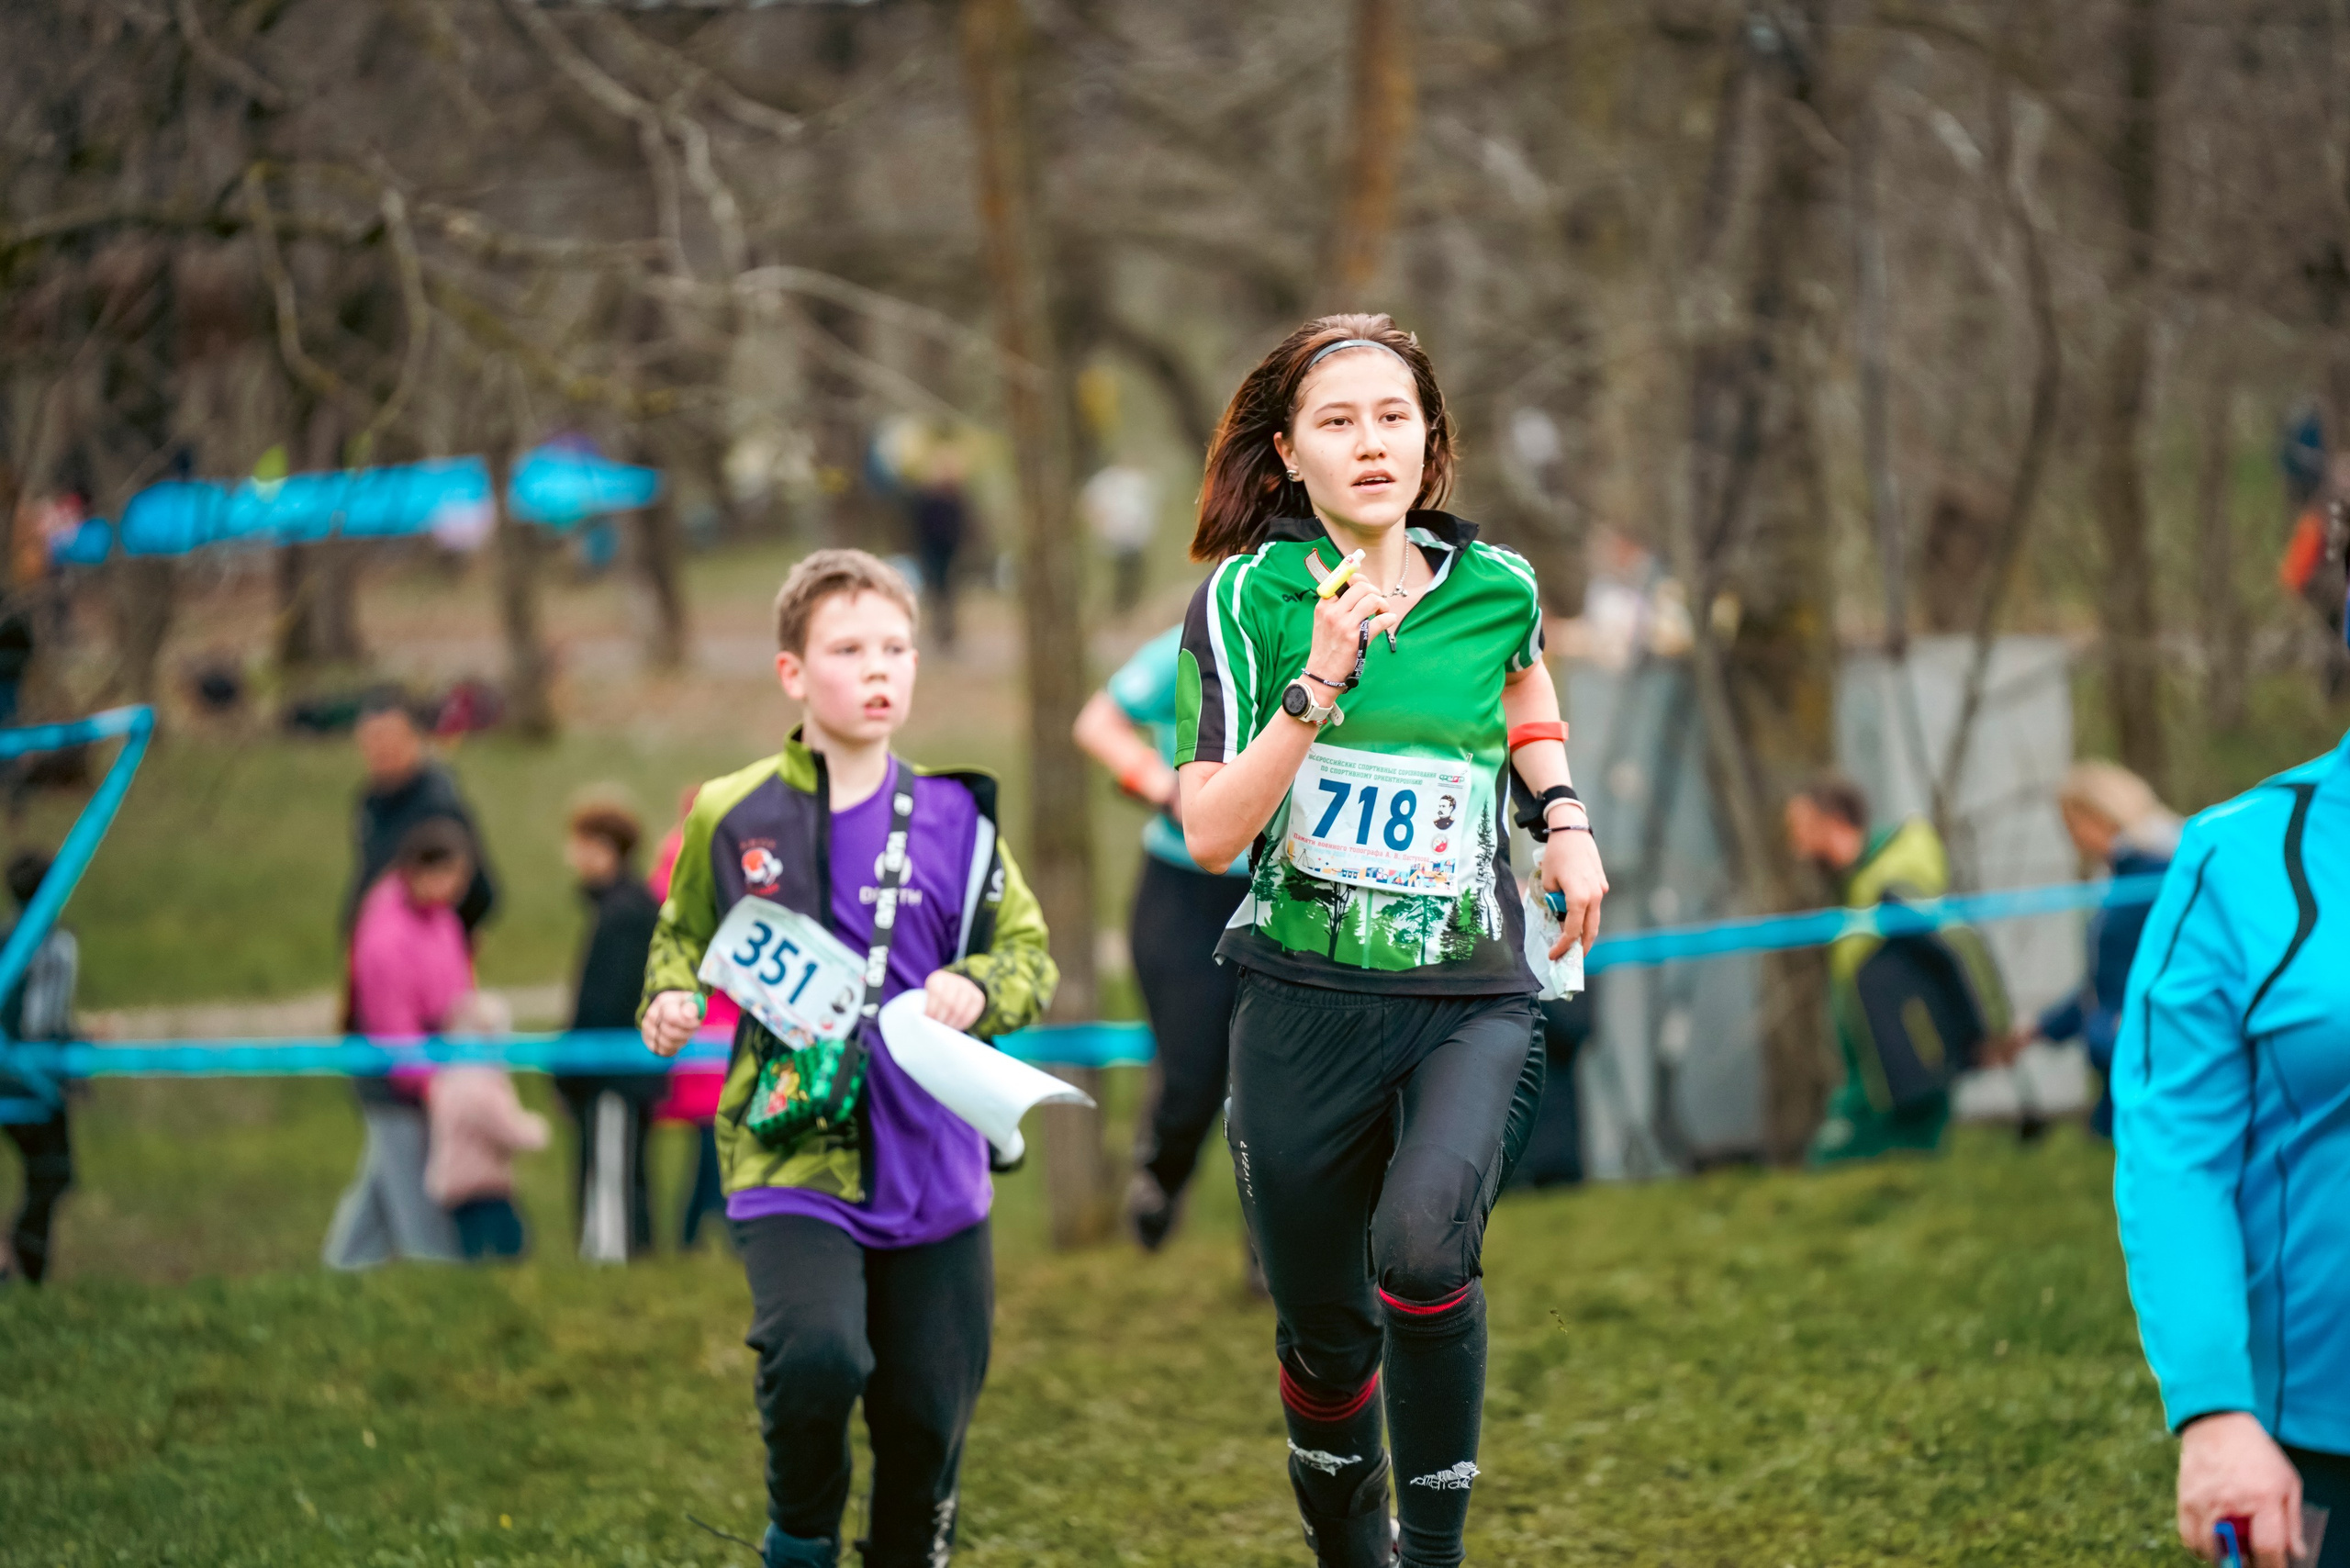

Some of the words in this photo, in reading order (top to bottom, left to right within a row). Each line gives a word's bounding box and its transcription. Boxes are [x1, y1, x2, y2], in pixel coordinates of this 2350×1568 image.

[1308, 754, 1357, 768] ВСЕРОССИЙСКИЕ
[1358, 762, 1397, 774] СПОРТИВНЫЕ
[1320, 765, 1329, 773] ПО
[1330, 767, 1372, 779] СПОРТИВНОМУ
[1312, 778, 1417, 852] 718
[1293, 832, 1316, 846] Памяти
[1317, 841, 1347, 851] военного
[1348, 846, 1383, 859] топографа
[732, 919, 819, 1005] 351
